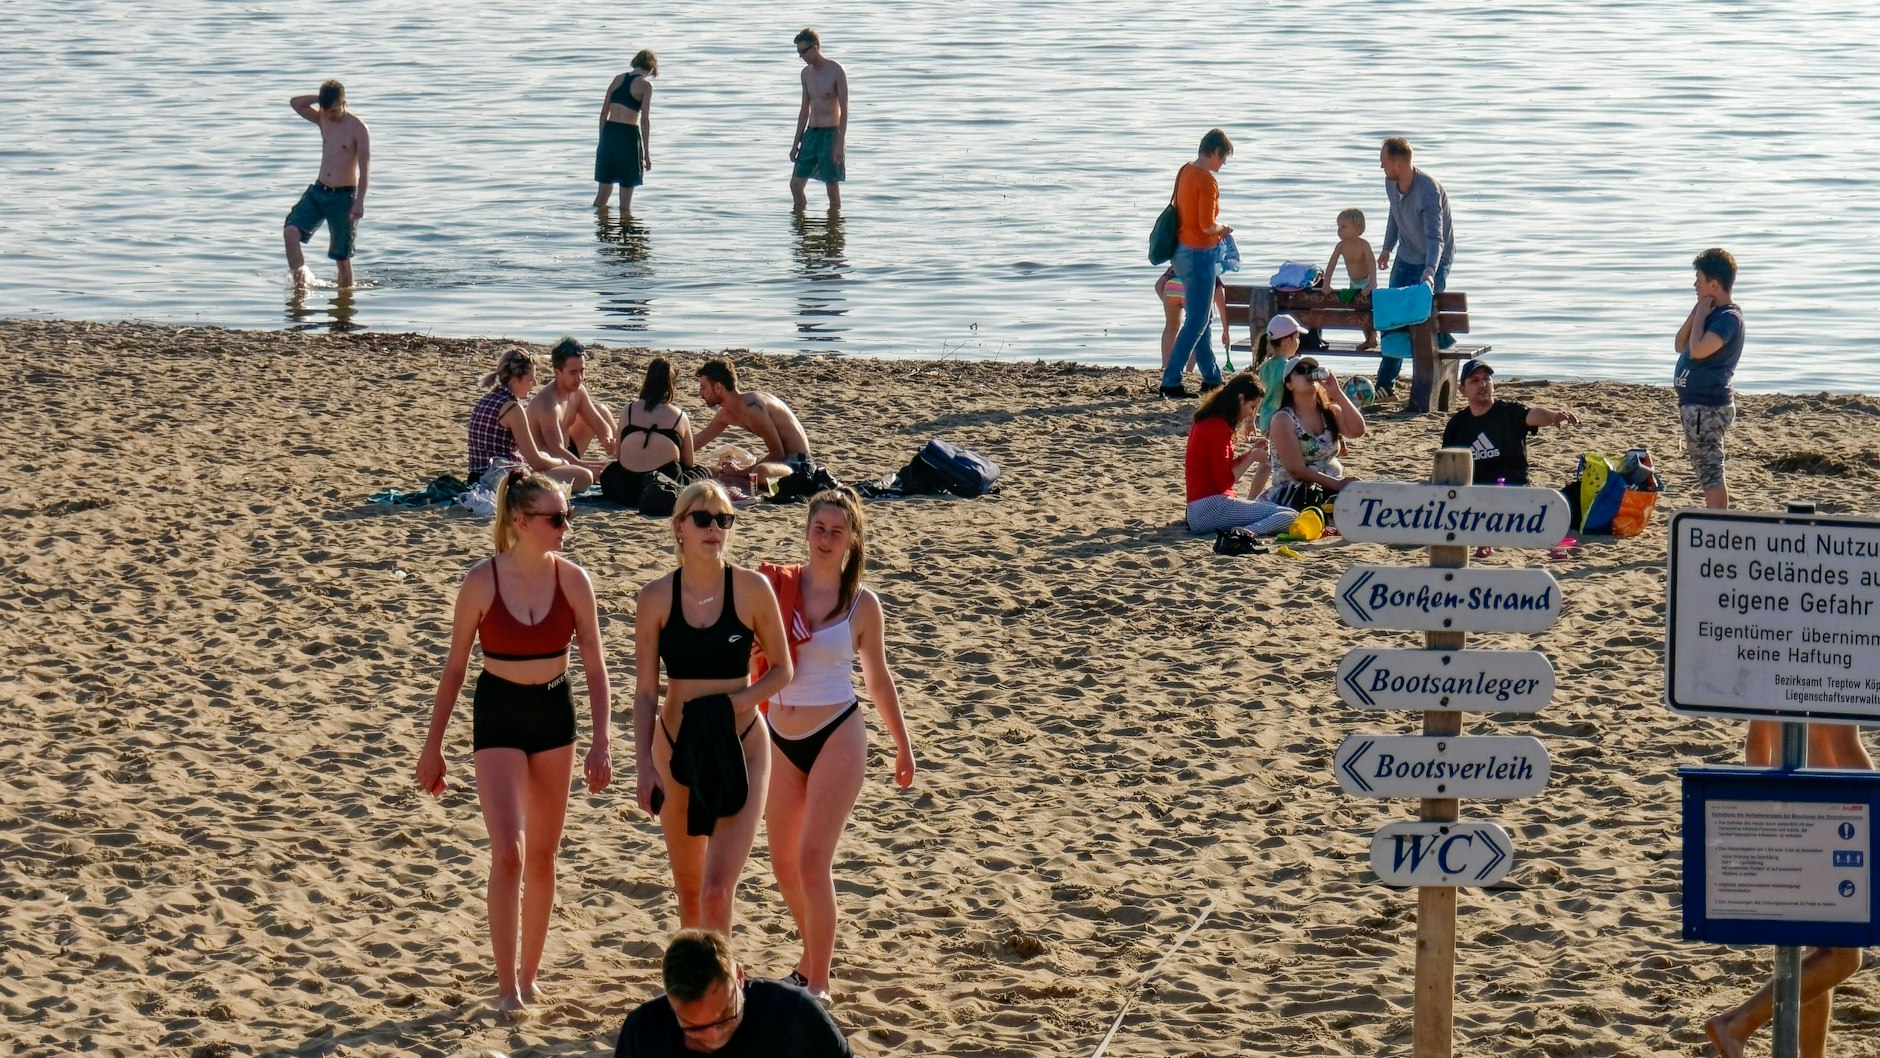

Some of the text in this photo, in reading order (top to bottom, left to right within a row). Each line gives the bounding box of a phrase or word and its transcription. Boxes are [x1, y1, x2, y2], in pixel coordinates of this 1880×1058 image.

[1472, 448, 1500, 460] didas
[1358, 498, 1548, 534] Textilstrand
[1690, 527, 1879, 558] Baden und Nutzu
[1700, 557, 1737, 579] des
[1749, 560, 1849, 586] Geländes
[1368, 583, 1552, 613] Borken-Strand
[1718, 588, 1874, 616] eigene Gefahr
[1699, 621, 1794, 642] Eigentümer
[1737, 644, 1852, 669] keine Haftung
[1369, 668, 1539, 701] Bootsanleger
[1775, 674, 1822, 688] Bezirksamt
[1827, 676, 1861, 691] Treptow
[1373, 754, 1533, 780] Bootsverleih
[1391, 834, 1473, 875] WC
